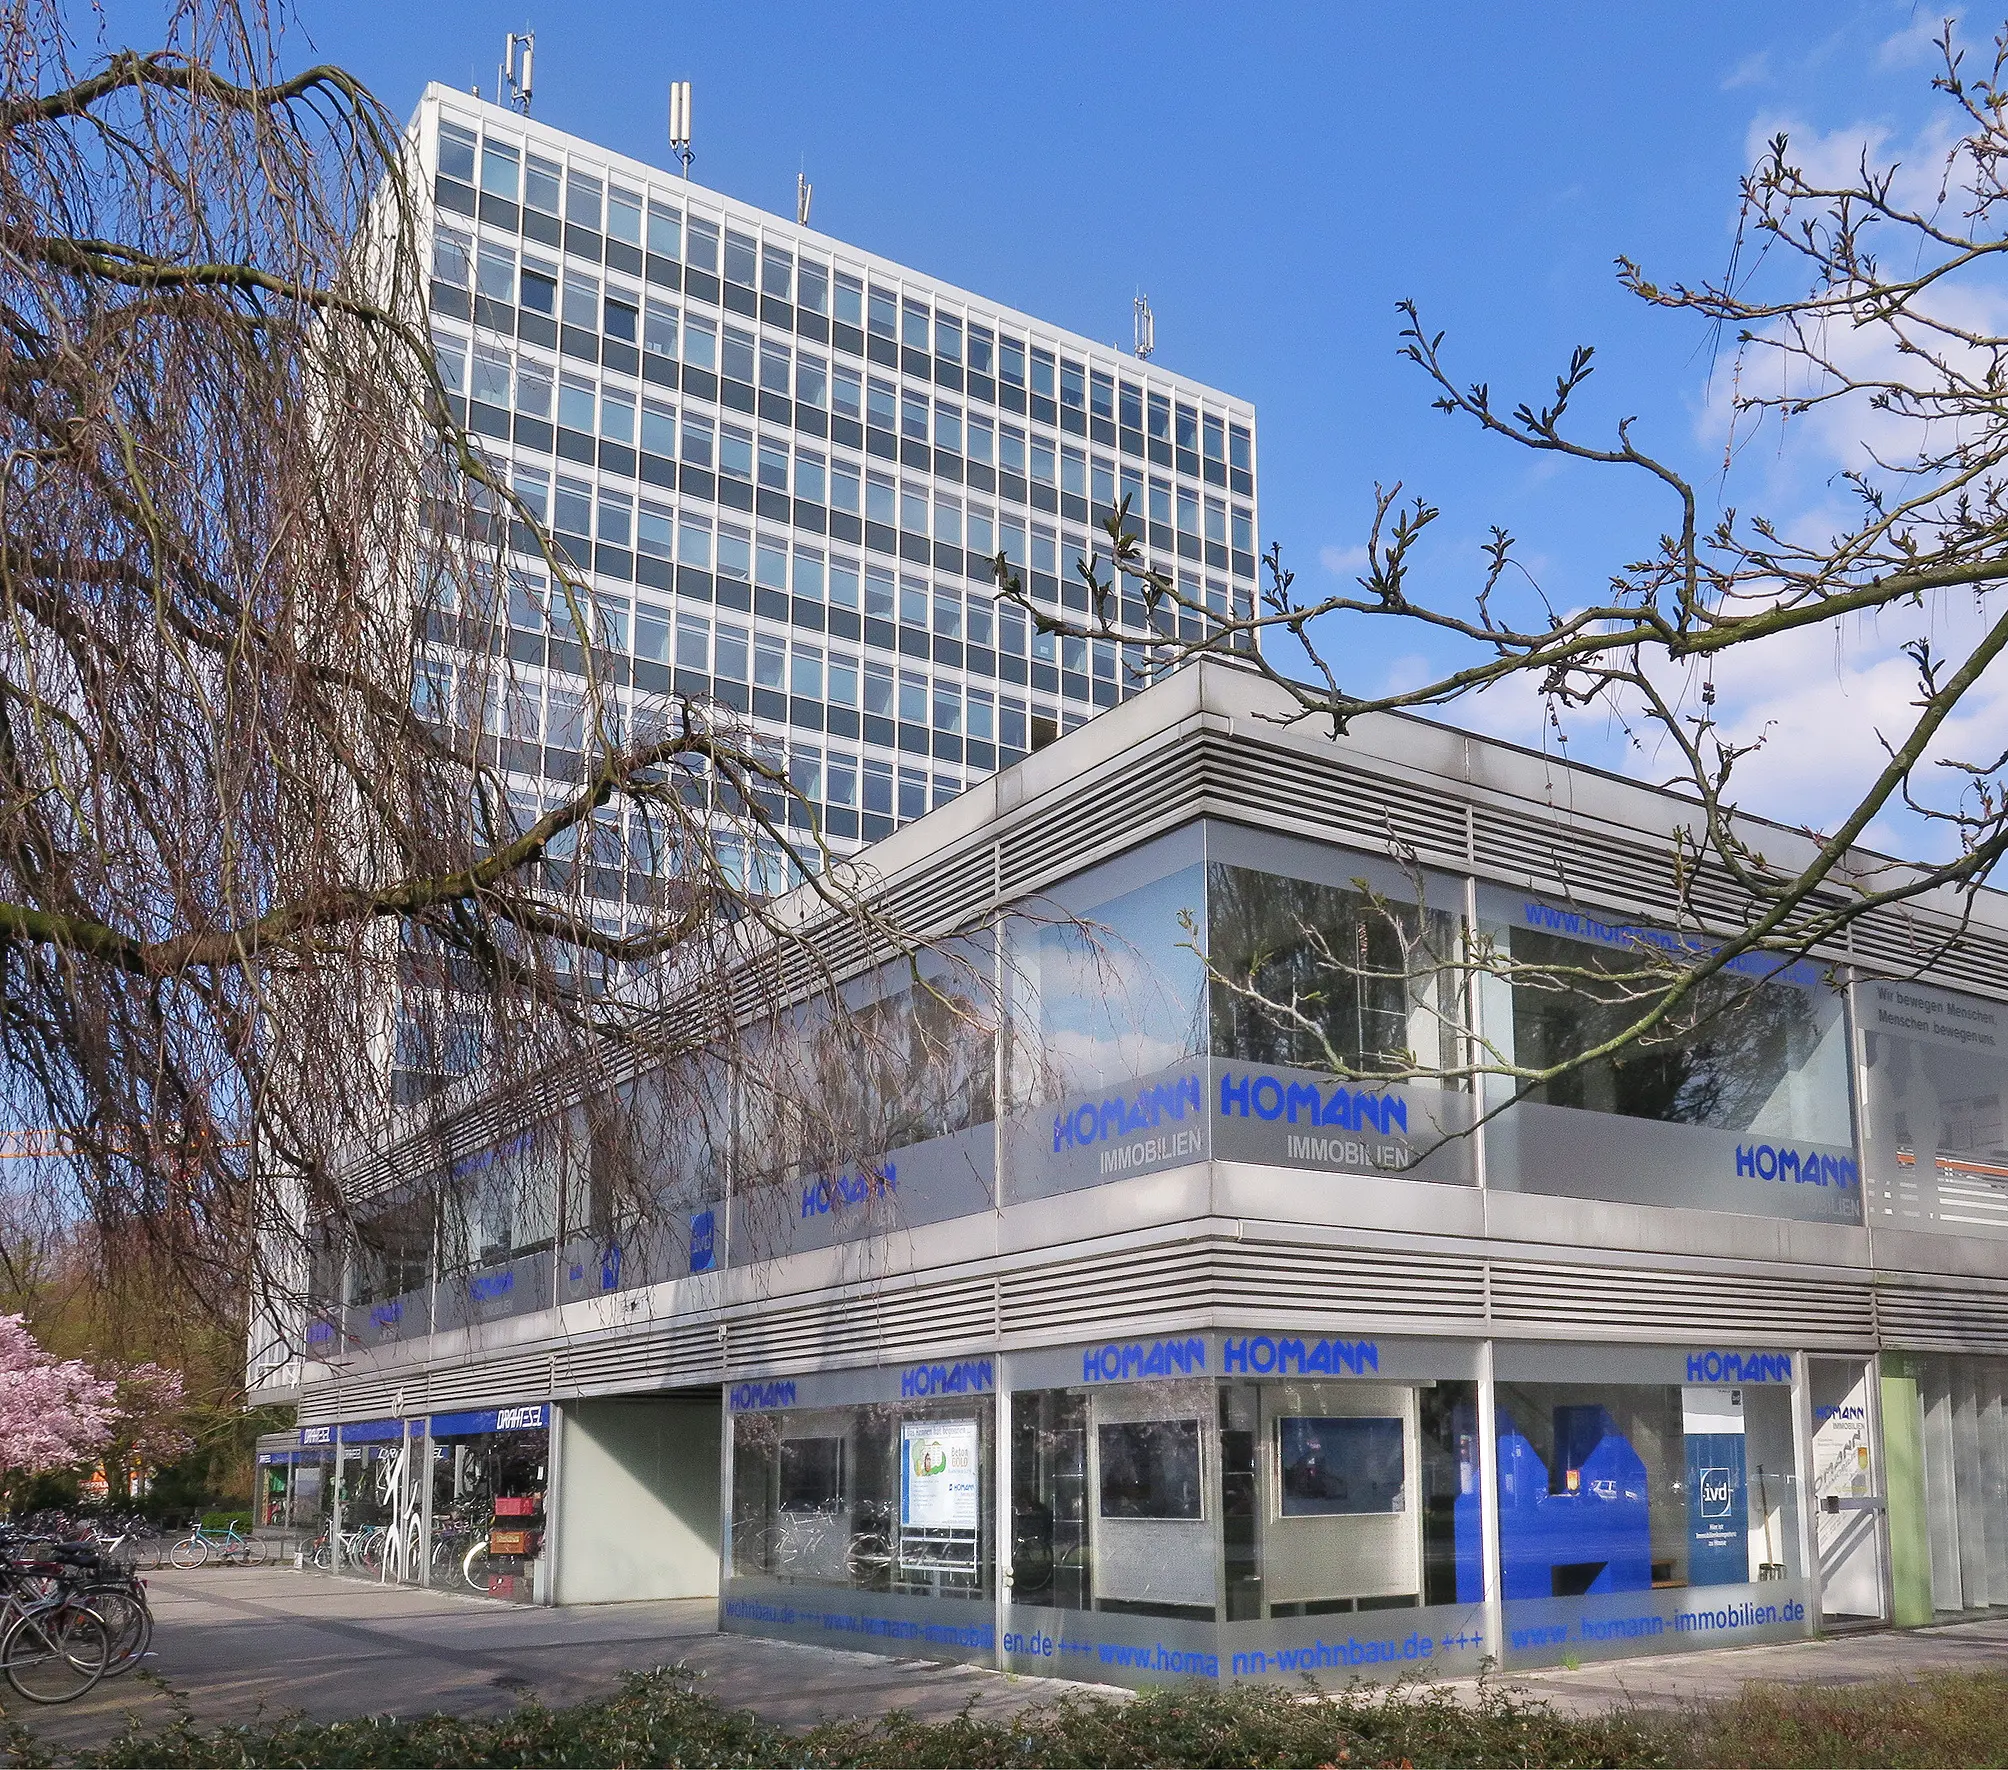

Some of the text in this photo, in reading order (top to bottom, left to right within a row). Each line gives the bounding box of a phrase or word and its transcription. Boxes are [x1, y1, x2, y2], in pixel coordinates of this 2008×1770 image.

[1876, 986, 1894, 1002] Wir
[1896, 991, 1943, 1014] bewegen
[1878, 1008, 1929, 1032] Menschen
[1932, 1021, 1978, 1043] bewegen
[1054, 1074, 1201, 1153] HOMANN
[1221, 1072, 1409, 1137] HOMANN
[1100, 1126, 1202, 1174] IMMOBILIEN
[1287, 1134, 1409, 1168] IMMOBILIEN
[1736, 1144, 1859, 1190] HOMANN
[1083, 1337, 1206, 1382] HOMANN
[1224, 1336, 1380, 1376] HOMANN
[1687, 1351, 1793, 1382] HOMANN
[730, 1381, 797, 1411] HOMANN
[901, 1361, 994, 1398] HOMANN
[1703, 1482, 1728, 1502] ivd
